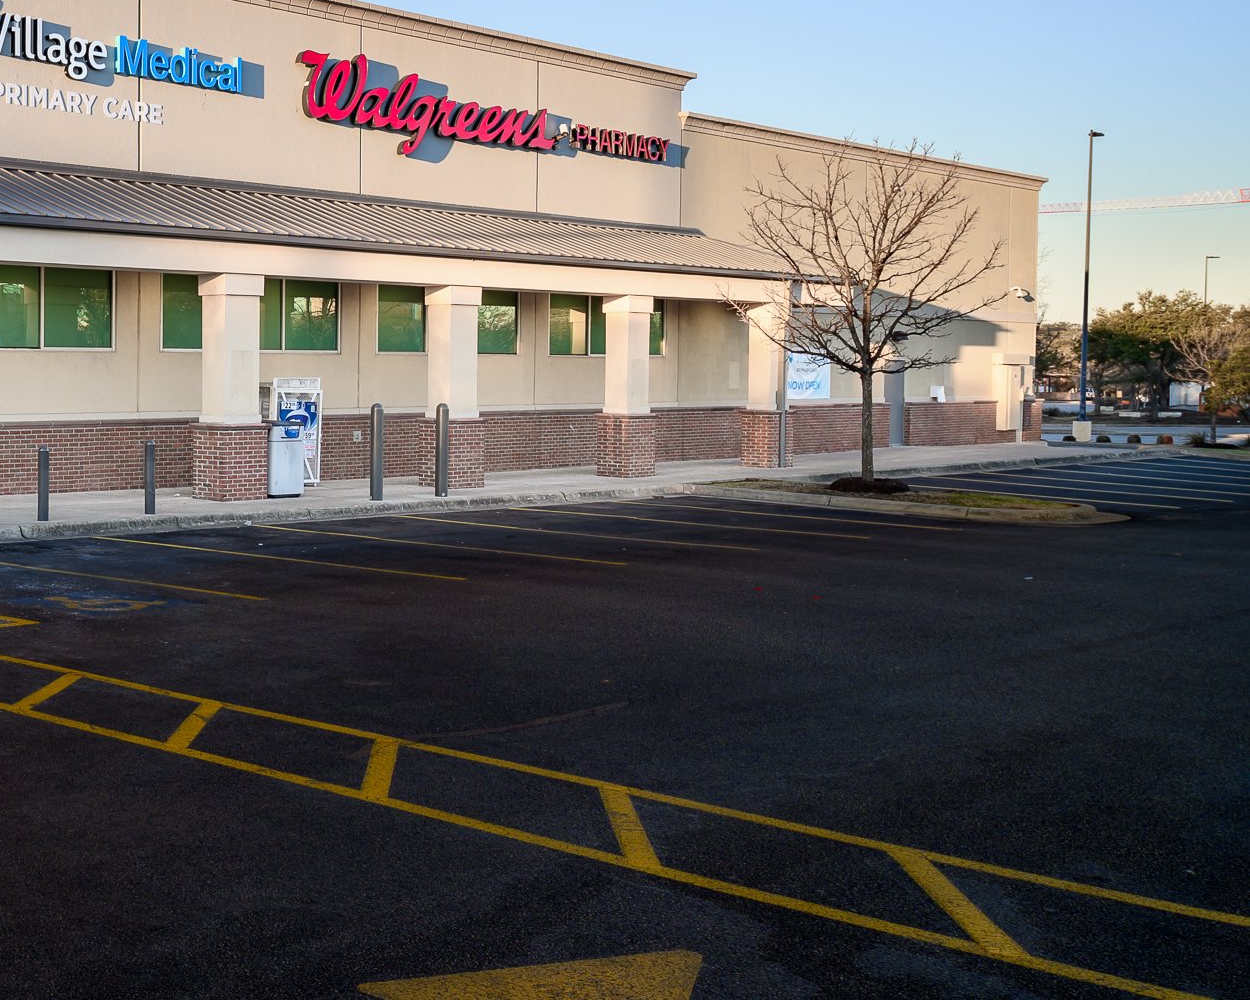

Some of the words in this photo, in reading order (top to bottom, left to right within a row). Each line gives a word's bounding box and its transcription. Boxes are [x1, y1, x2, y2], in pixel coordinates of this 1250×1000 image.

[115, 34, 243, 93] Medical
[103, 97, 165, 126] CARE
[296, 50, 554, 155] Walgreens
[572, 124, 671, 163] PHARMACY
